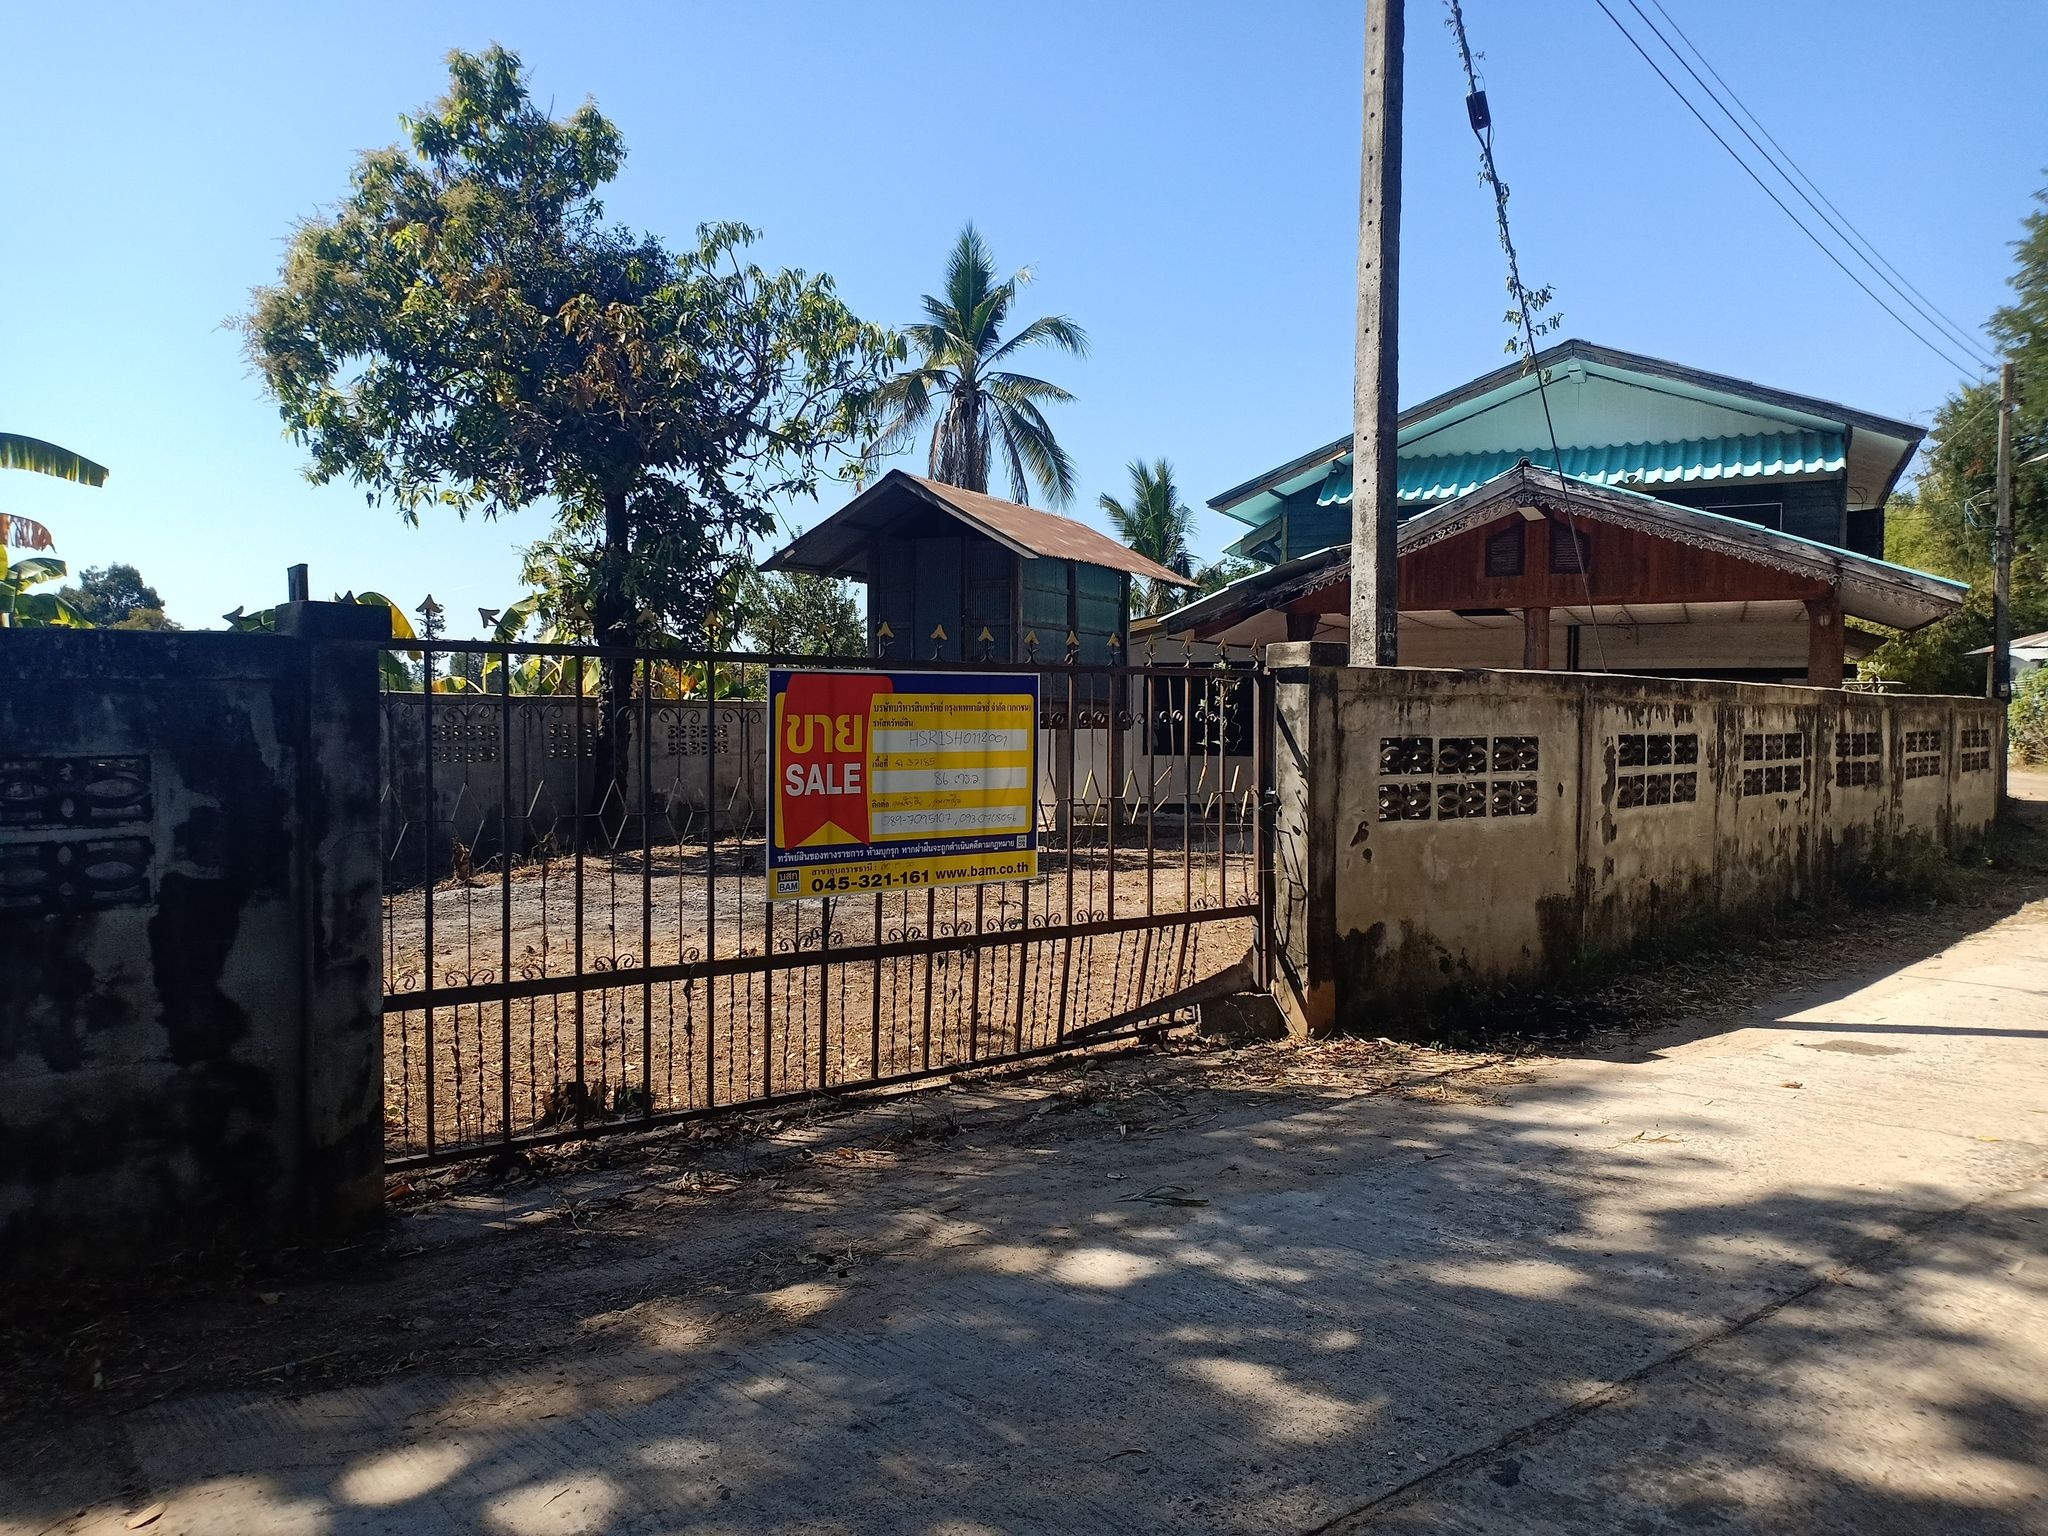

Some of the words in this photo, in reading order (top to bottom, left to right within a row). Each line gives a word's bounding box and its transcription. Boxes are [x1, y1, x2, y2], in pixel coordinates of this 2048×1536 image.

[786, 714, 863, 754] ขาย
[785, 763, 862, 797] SALE
[933, 771, 949, 786] 86
[866, 846, 900, 858] ห้ามบุกรุก
[779, 882, 798, 891] BAM
[811, 870, 929, 892] 045-321-161
[935, 862, 1029, 879] www.bam.co.th
